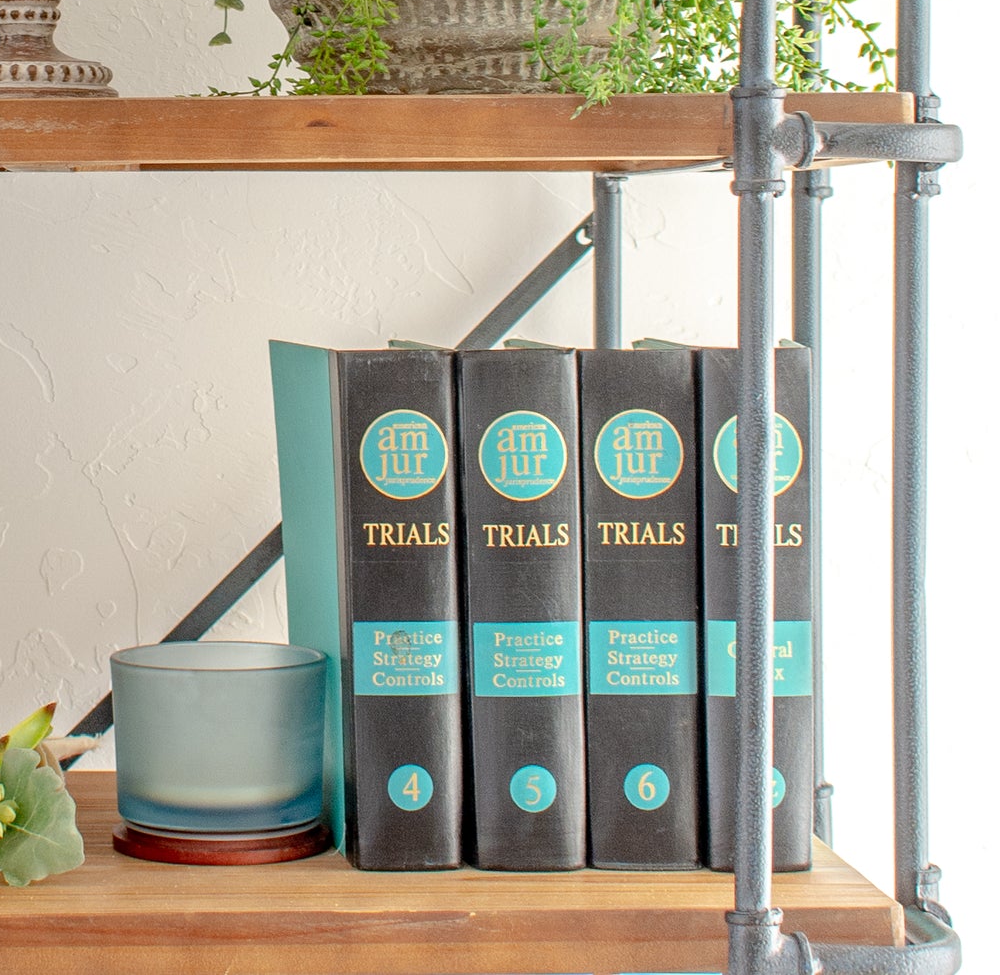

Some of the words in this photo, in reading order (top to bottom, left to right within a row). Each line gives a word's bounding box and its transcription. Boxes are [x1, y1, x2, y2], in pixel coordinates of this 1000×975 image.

[377, 426, 430, 451] am
[496, 428, 548, 453] am
[612, 426, 664, 451] am
[376, 453, 428, 481] jur
[495, 454, 548, 482] jur
[610, 452, 663, 480] jur
[363, 522, 451, 546] TRIALS
[482, 523, 571, 547] TRIALS
[597, 522, 686, 546] TRIALS
[715, 524, 803, 547] TLS
[373, 630, 443, 645] Practice
[494, 631, 564, 646] Practice
[607, 629, 679, 644] Practice
[373, 651, 442, 668] Strategy
[493, 652, 564, 669] Strategy
[607, 650, 678, 667] Strategy
[372, 671, 445, 687] Controls
[492, 673, 566, 688] Controls
[606, 671, 680, 686] Controls
[402, 772, 421, 802] 4
[525, 776, 542, 805] 5
[637, 771, 656, 801] 6
